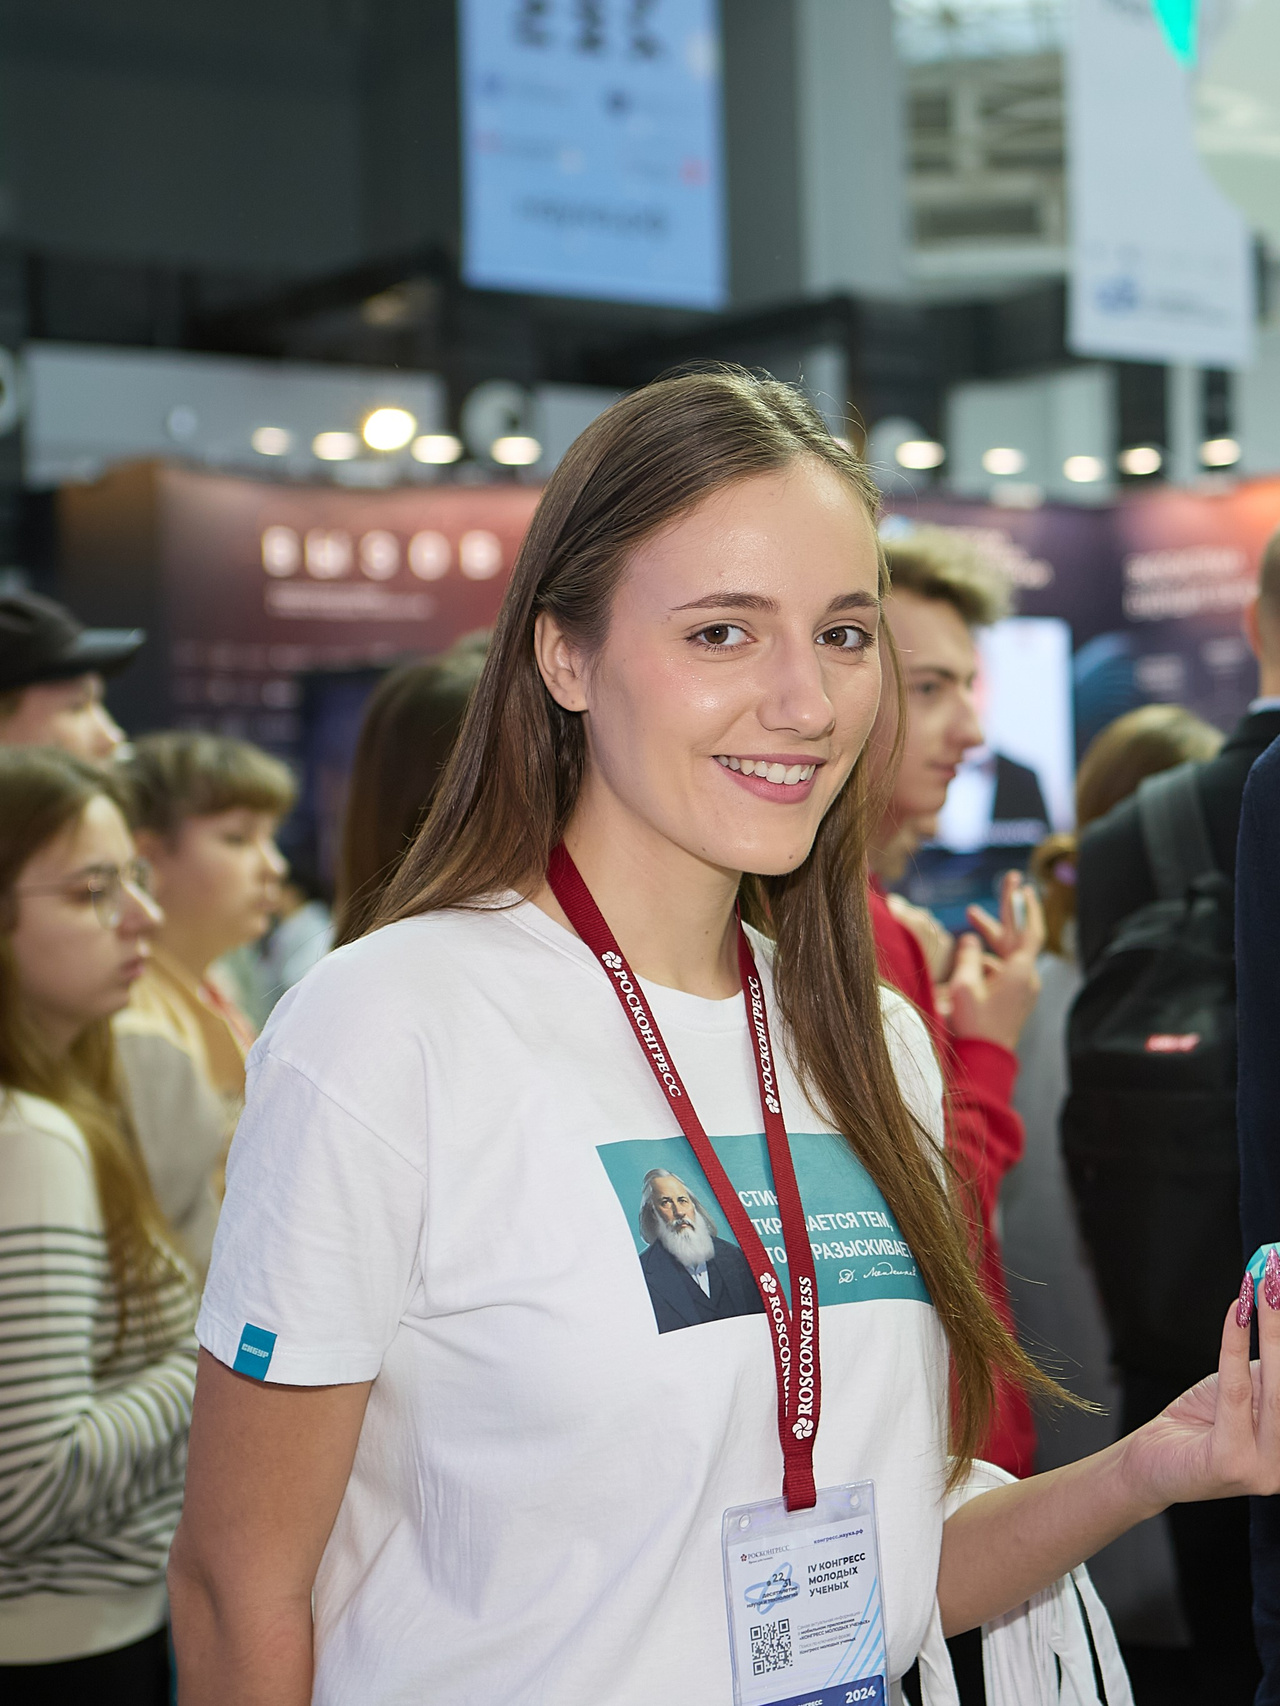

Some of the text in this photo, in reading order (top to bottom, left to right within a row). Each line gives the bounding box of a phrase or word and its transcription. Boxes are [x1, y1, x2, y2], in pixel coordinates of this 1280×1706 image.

[614, 970, 682, 1098] РОСКОНГРЕСС
[747, 975, 775, 1096] РОСКОНГРЕСС
[857, 1211, 894, 1232] ТЕМ,
[765, 1246, 787, 1264] ТО
[241, 1343, 269, 1358] СИБУР
[798, 1276, 814, 1416] ROSCONGRESS
[748, 1545, 790, 1560] РОСКОНГРЕСС
[808, 1552, 866, 1574] IV КОНГРЕСС
[772, 1572, 784, 1582] 22
[809, 1566, 859, 1586] МОЛОДЫХ
[809, 1580, 850, 1597] УЧЕНЫХ
[845, 1685, 877, 1704] 2024
